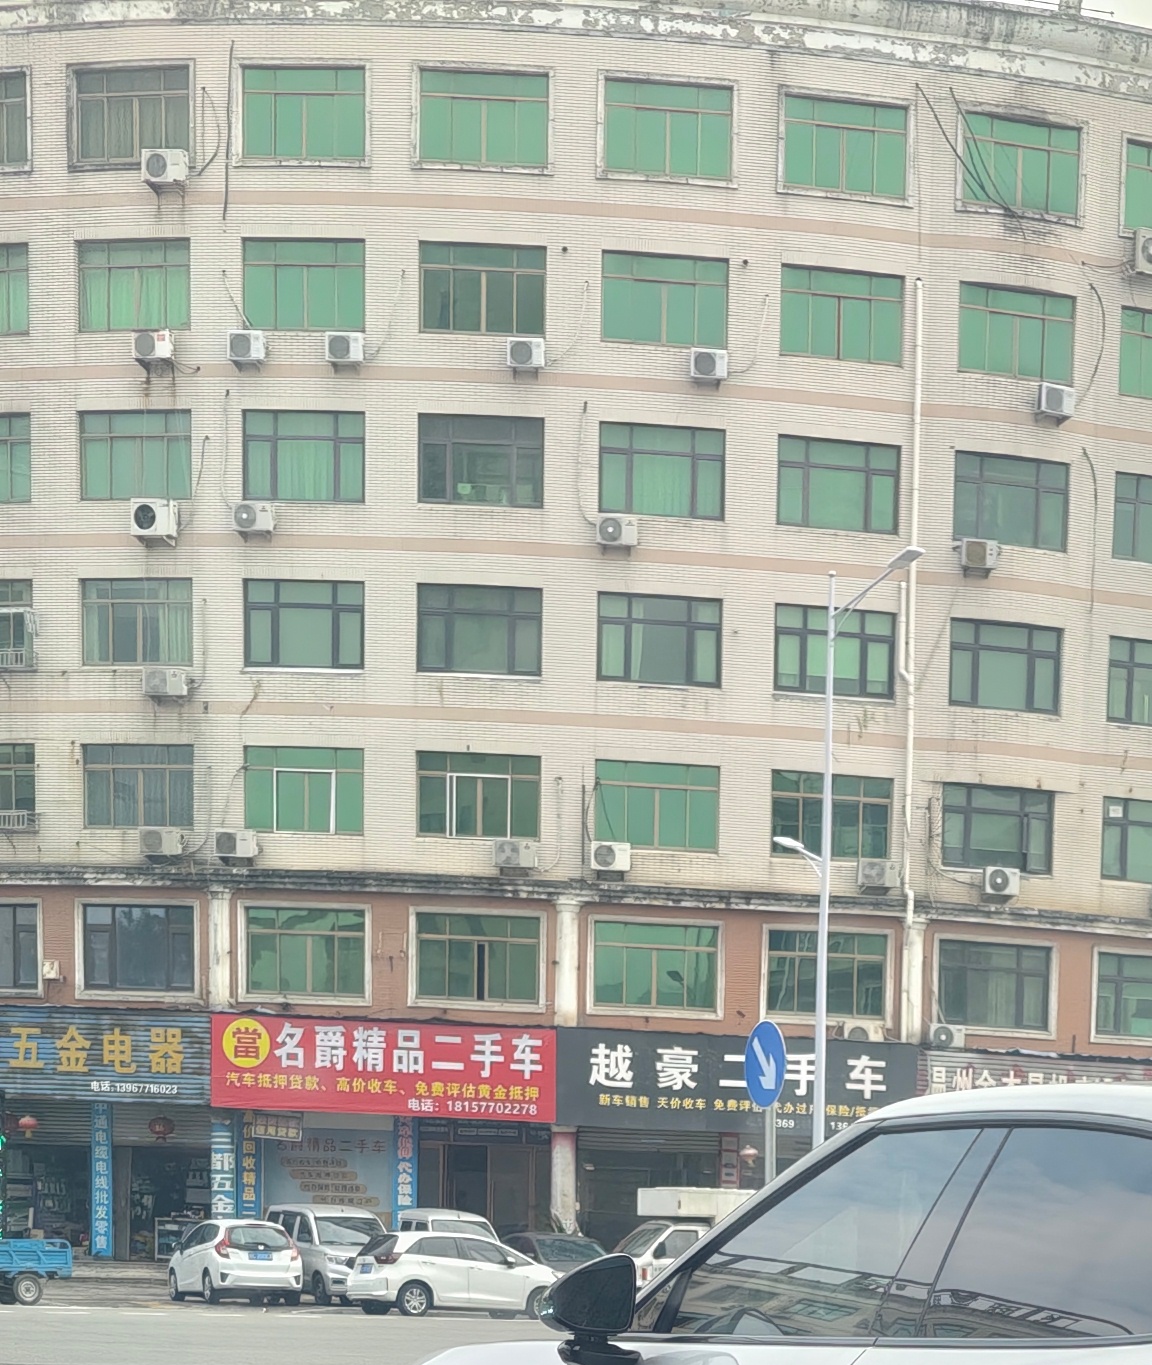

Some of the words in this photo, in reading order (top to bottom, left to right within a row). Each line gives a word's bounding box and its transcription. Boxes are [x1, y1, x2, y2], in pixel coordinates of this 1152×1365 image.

[9, 1025, 185, 1074] 五金电器
[273, 1022, 543, 1080] 名爵精品二手车
[589, 1043, 887, 1099] 越豪二手车
